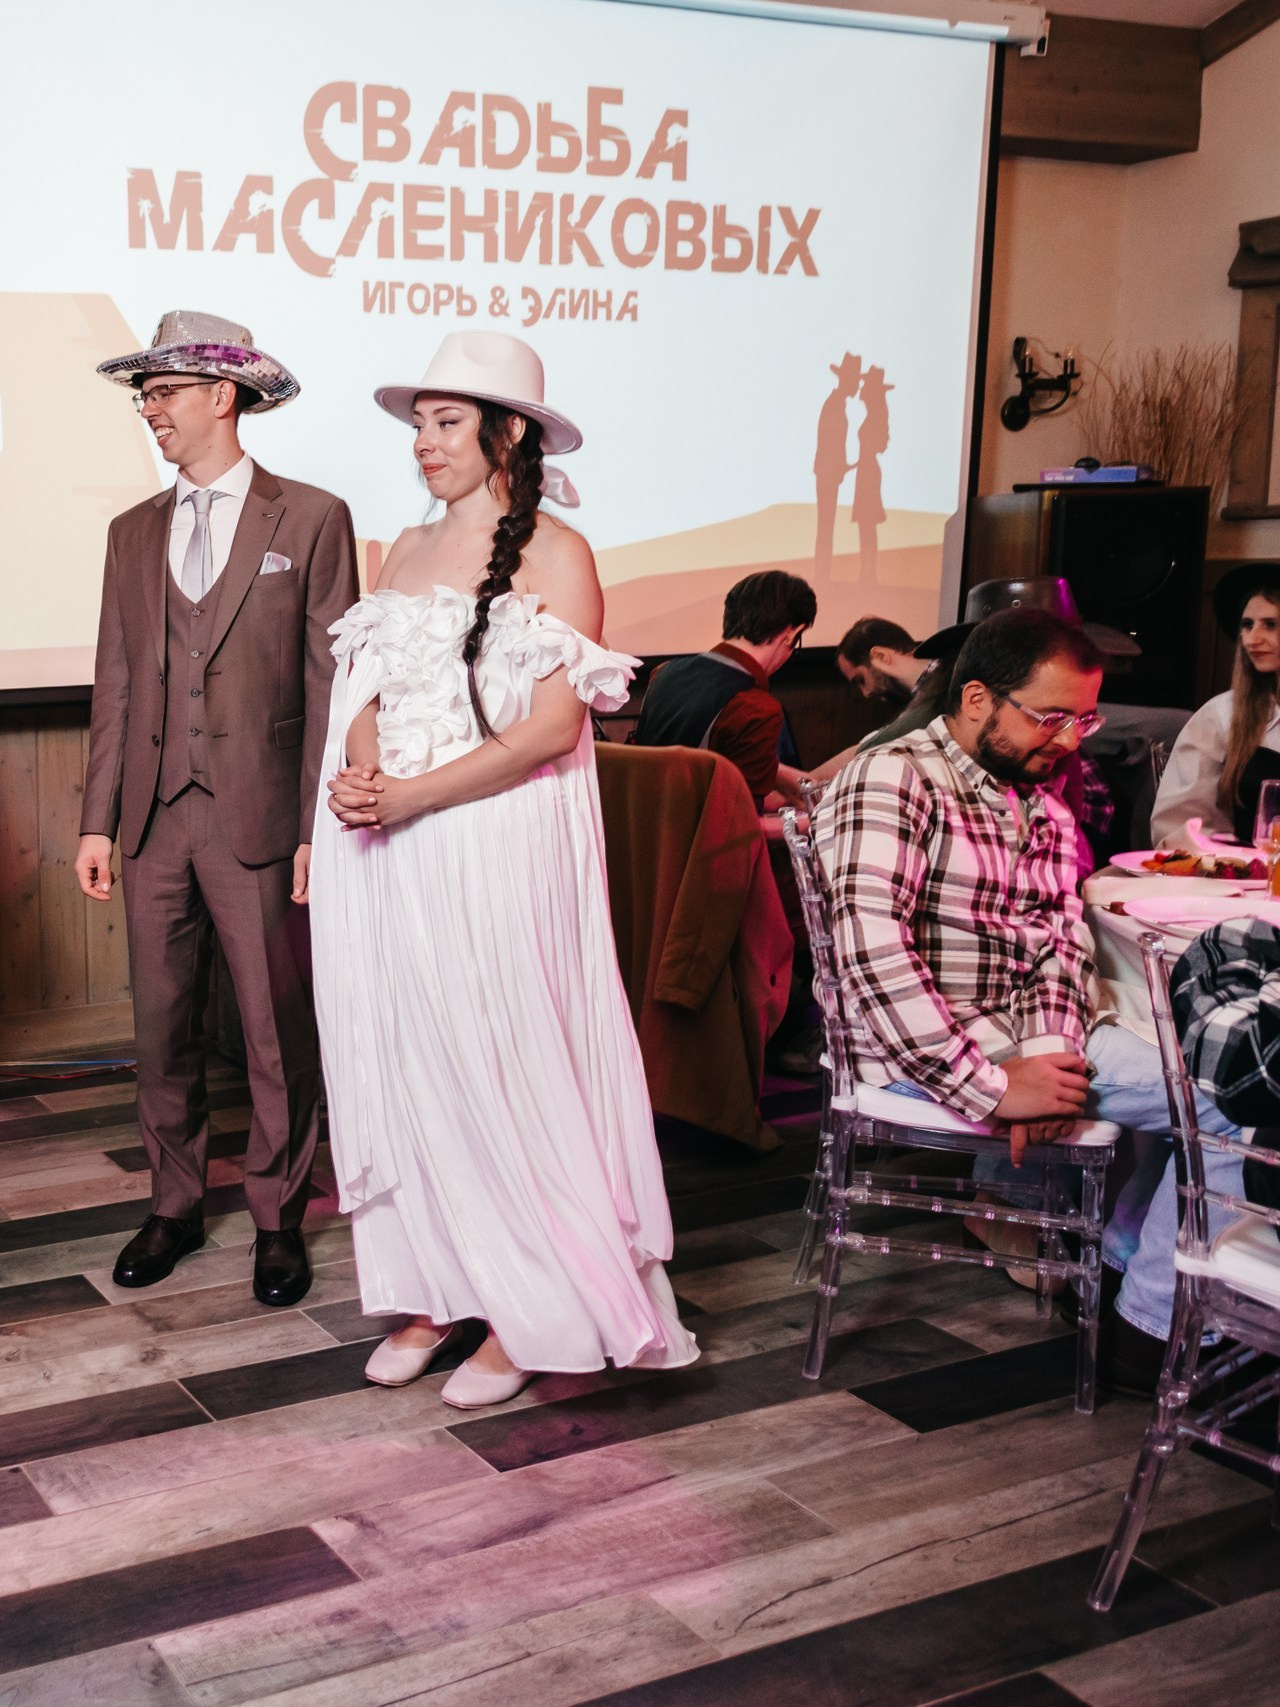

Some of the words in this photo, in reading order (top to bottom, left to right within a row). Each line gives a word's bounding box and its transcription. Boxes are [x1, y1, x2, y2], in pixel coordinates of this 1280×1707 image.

[126, 167, 821, 279] МАСЛЕНИКОВЫХ
[362, 280, 478, 318] ИГОРЬ
[488, 285, 510, 318] &
[521, 286, 640, 328] ЭЛИНА
